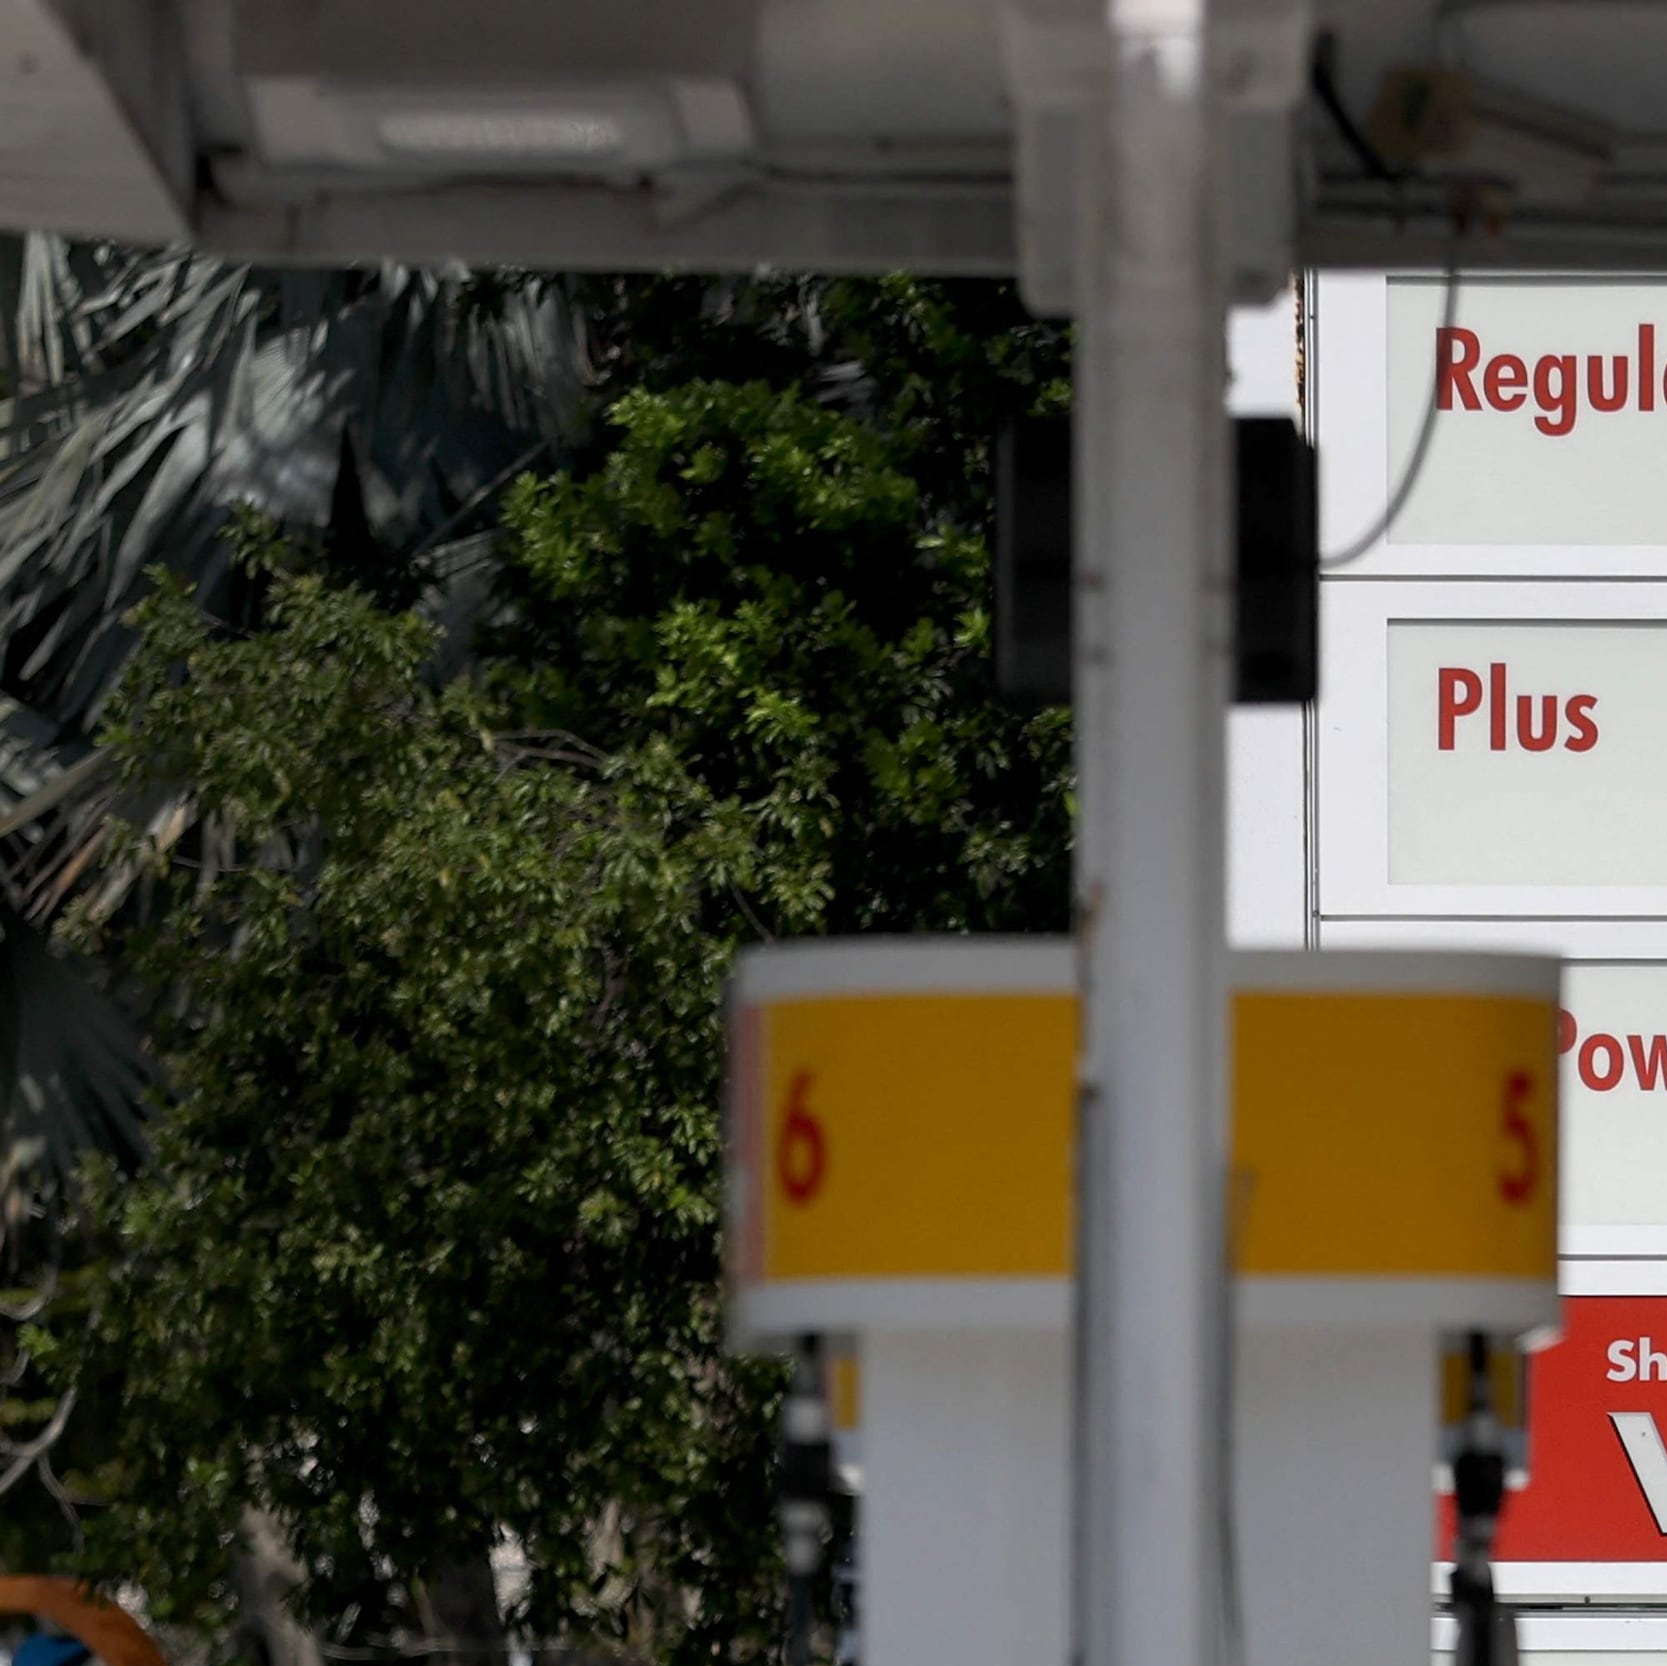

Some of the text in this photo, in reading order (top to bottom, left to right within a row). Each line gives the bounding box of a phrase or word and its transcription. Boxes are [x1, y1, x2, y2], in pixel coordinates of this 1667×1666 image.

[1438, 662, 1599, 753] Plus
[775, 1066, 828, 1208] 6
[1494, 1068, 1542, 1206] 5
